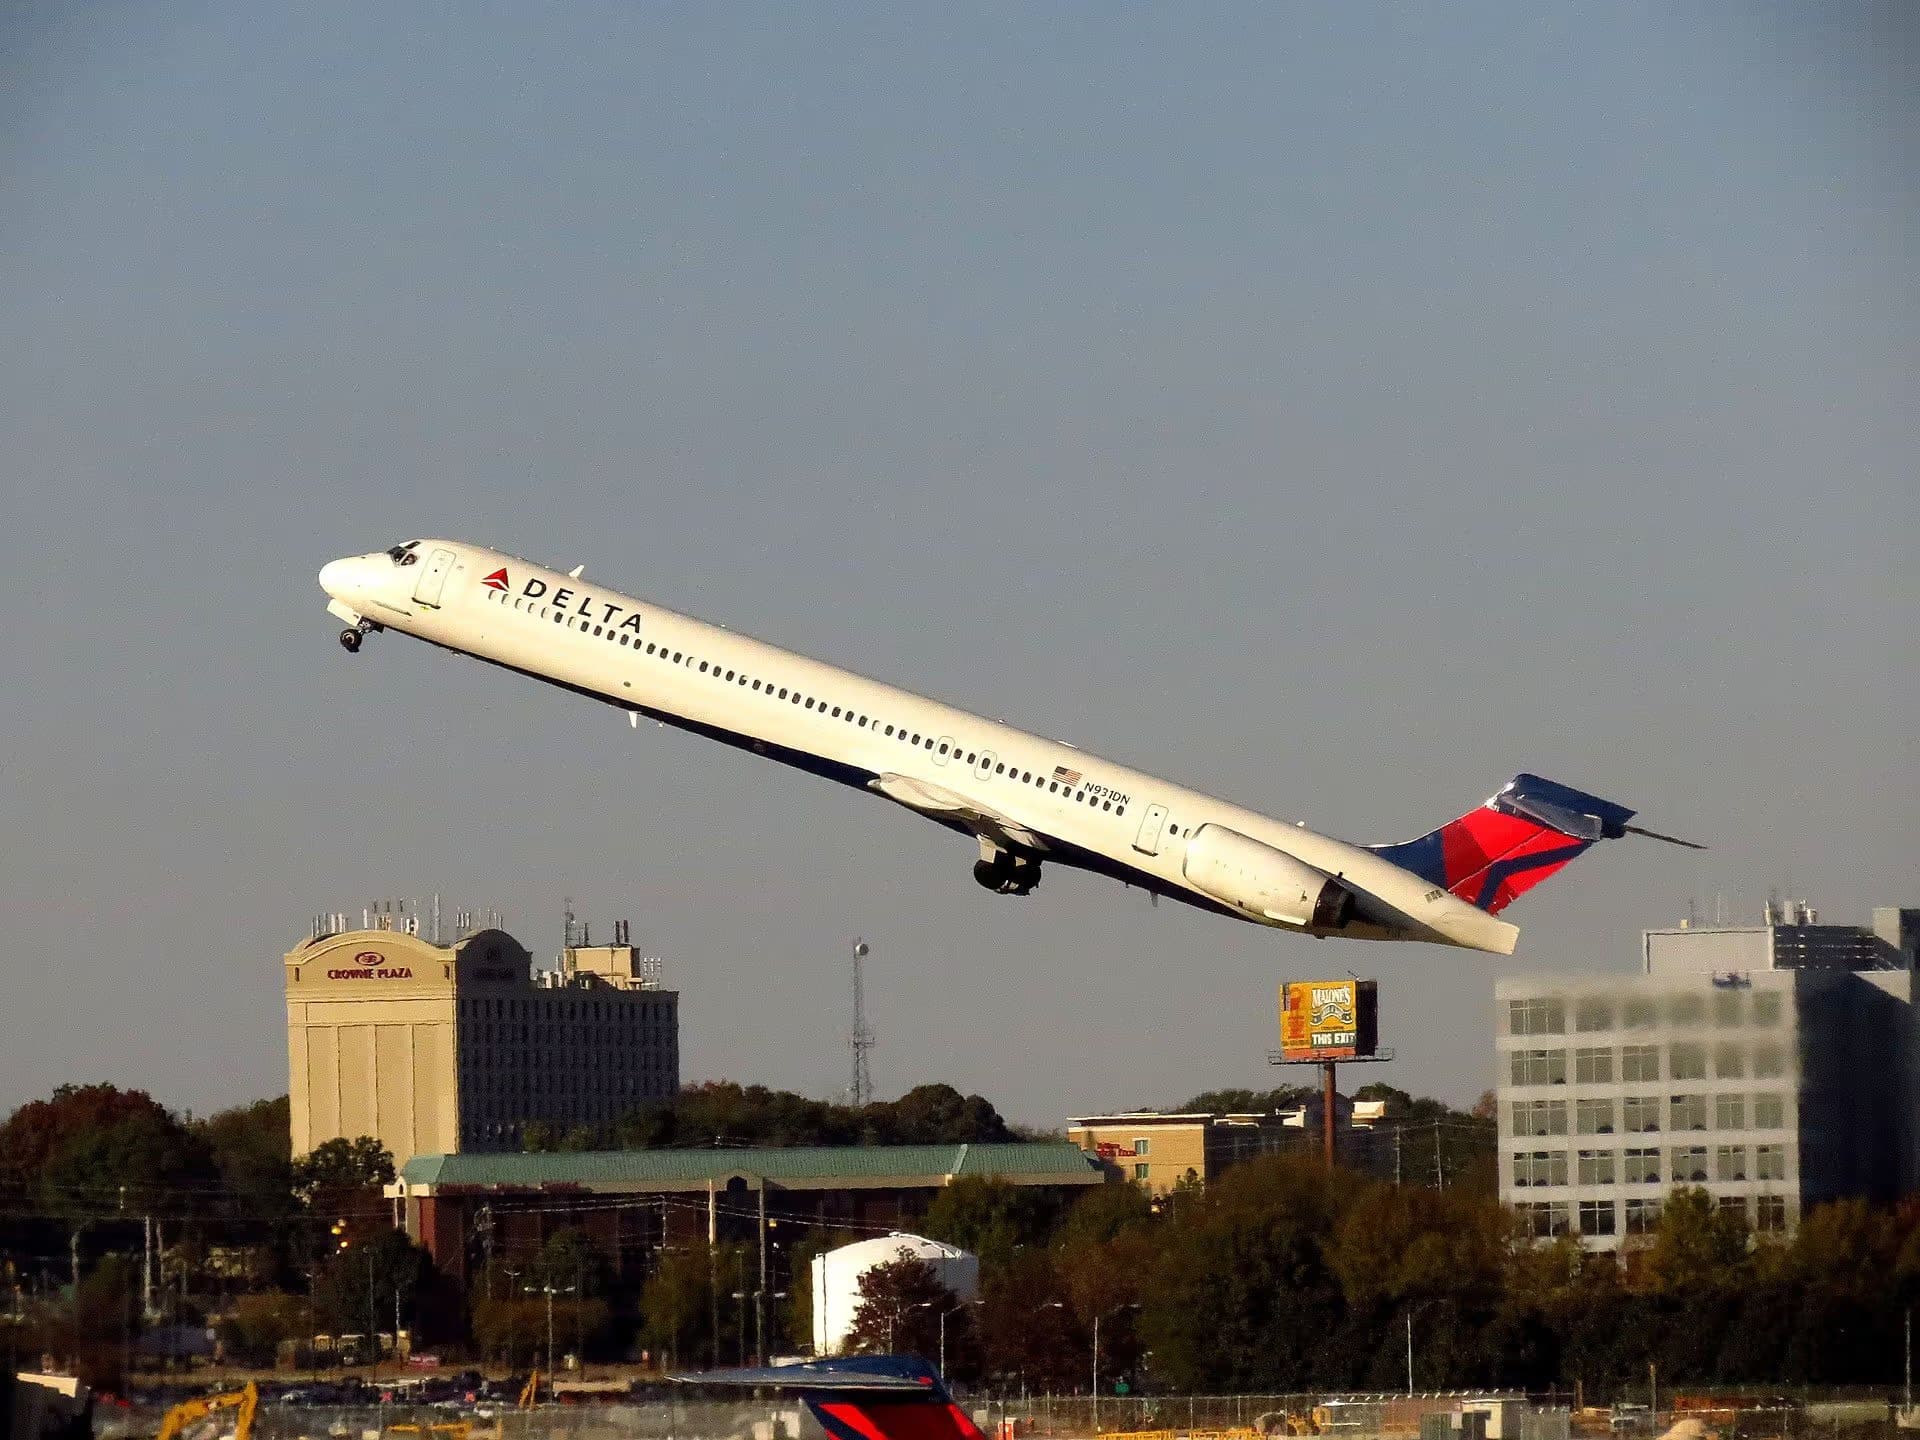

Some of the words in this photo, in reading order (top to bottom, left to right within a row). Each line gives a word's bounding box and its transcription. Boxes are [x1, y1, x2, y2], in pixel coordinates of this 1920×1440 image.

[522, 578, 642, 633] DELTA
[1084, 781, 1131, 805] N931DN
[327, 968, 374, 979] CROWNE
[377, 967, 413, 978] PLAZA
[1312, 1033, 1332, 1045] THIS
[1334, 1032, 1355, 1044] EXIT
